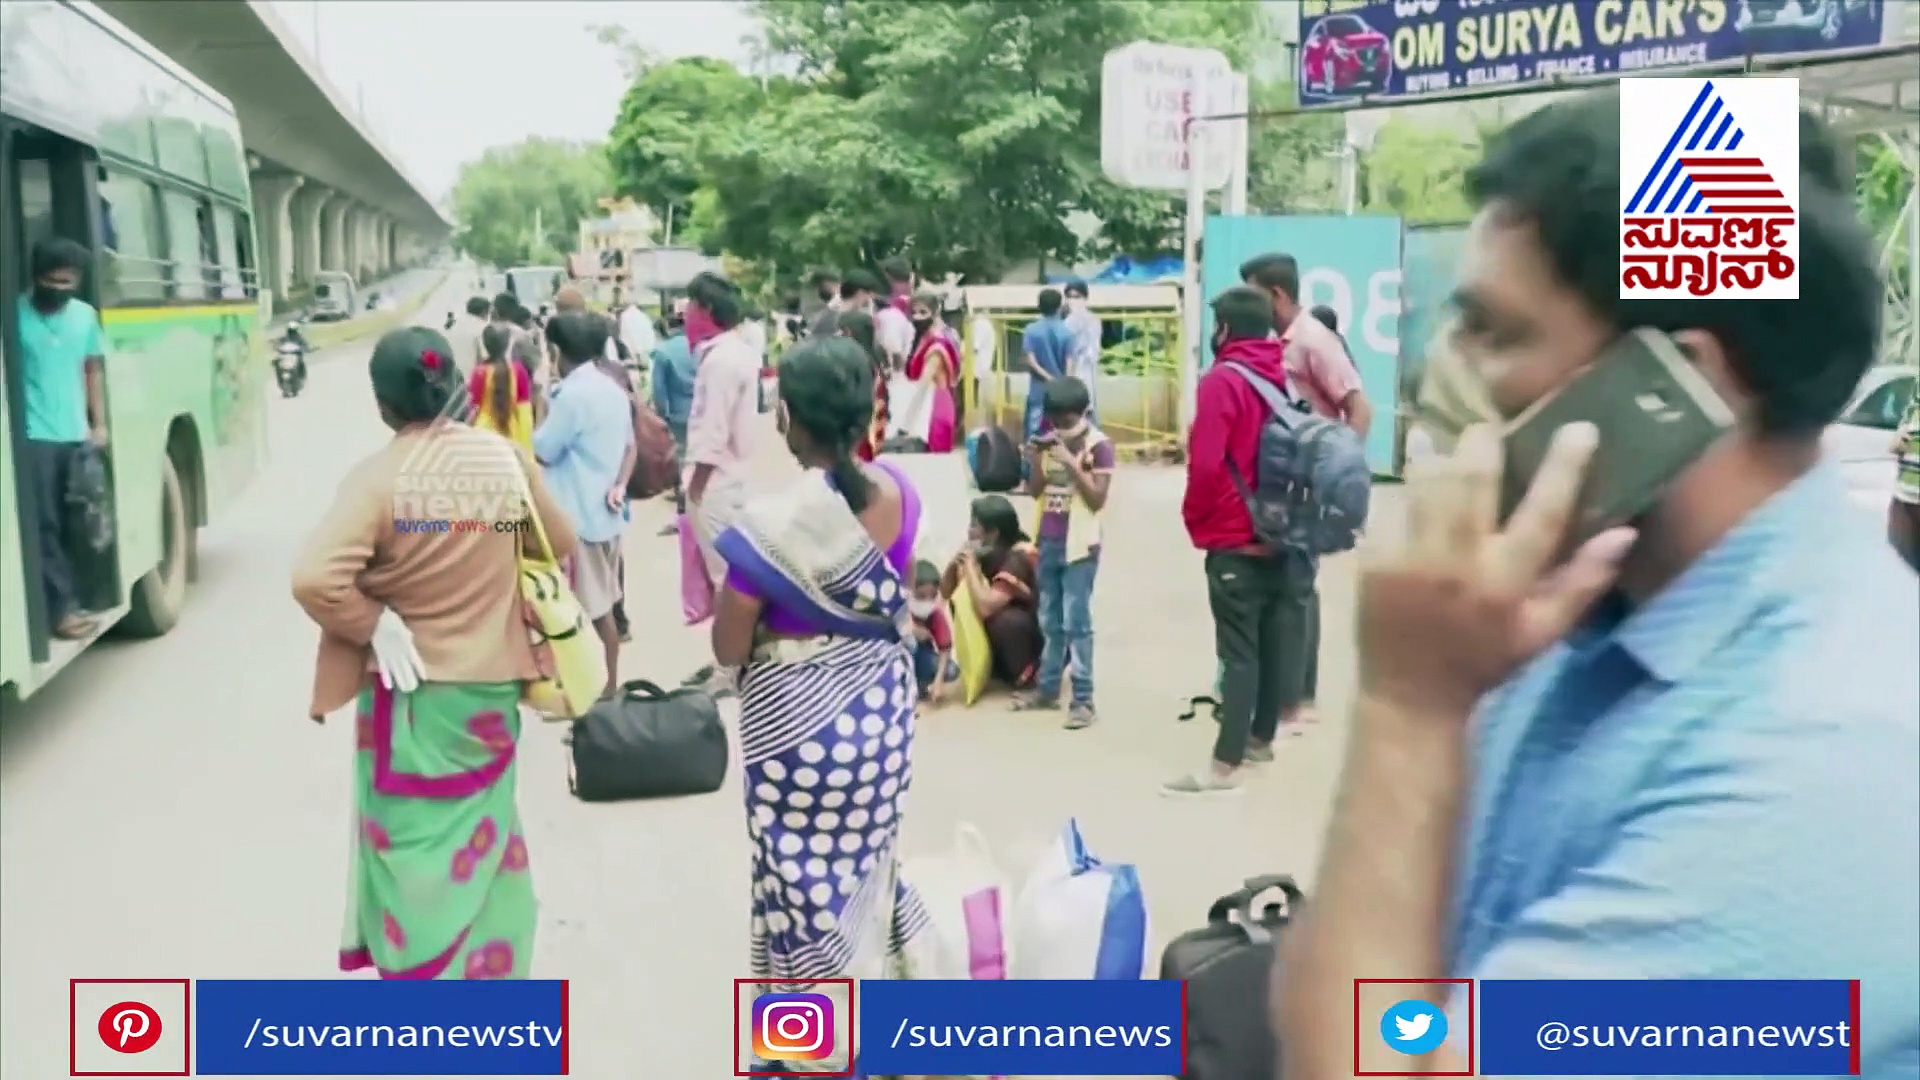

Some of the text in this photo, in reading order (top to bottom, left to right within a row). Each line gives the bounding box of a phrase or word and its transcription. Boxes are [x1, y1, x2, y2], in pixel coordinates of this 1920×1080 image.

[1393, 0, 1727, 70] OM SURYA CAR'S
